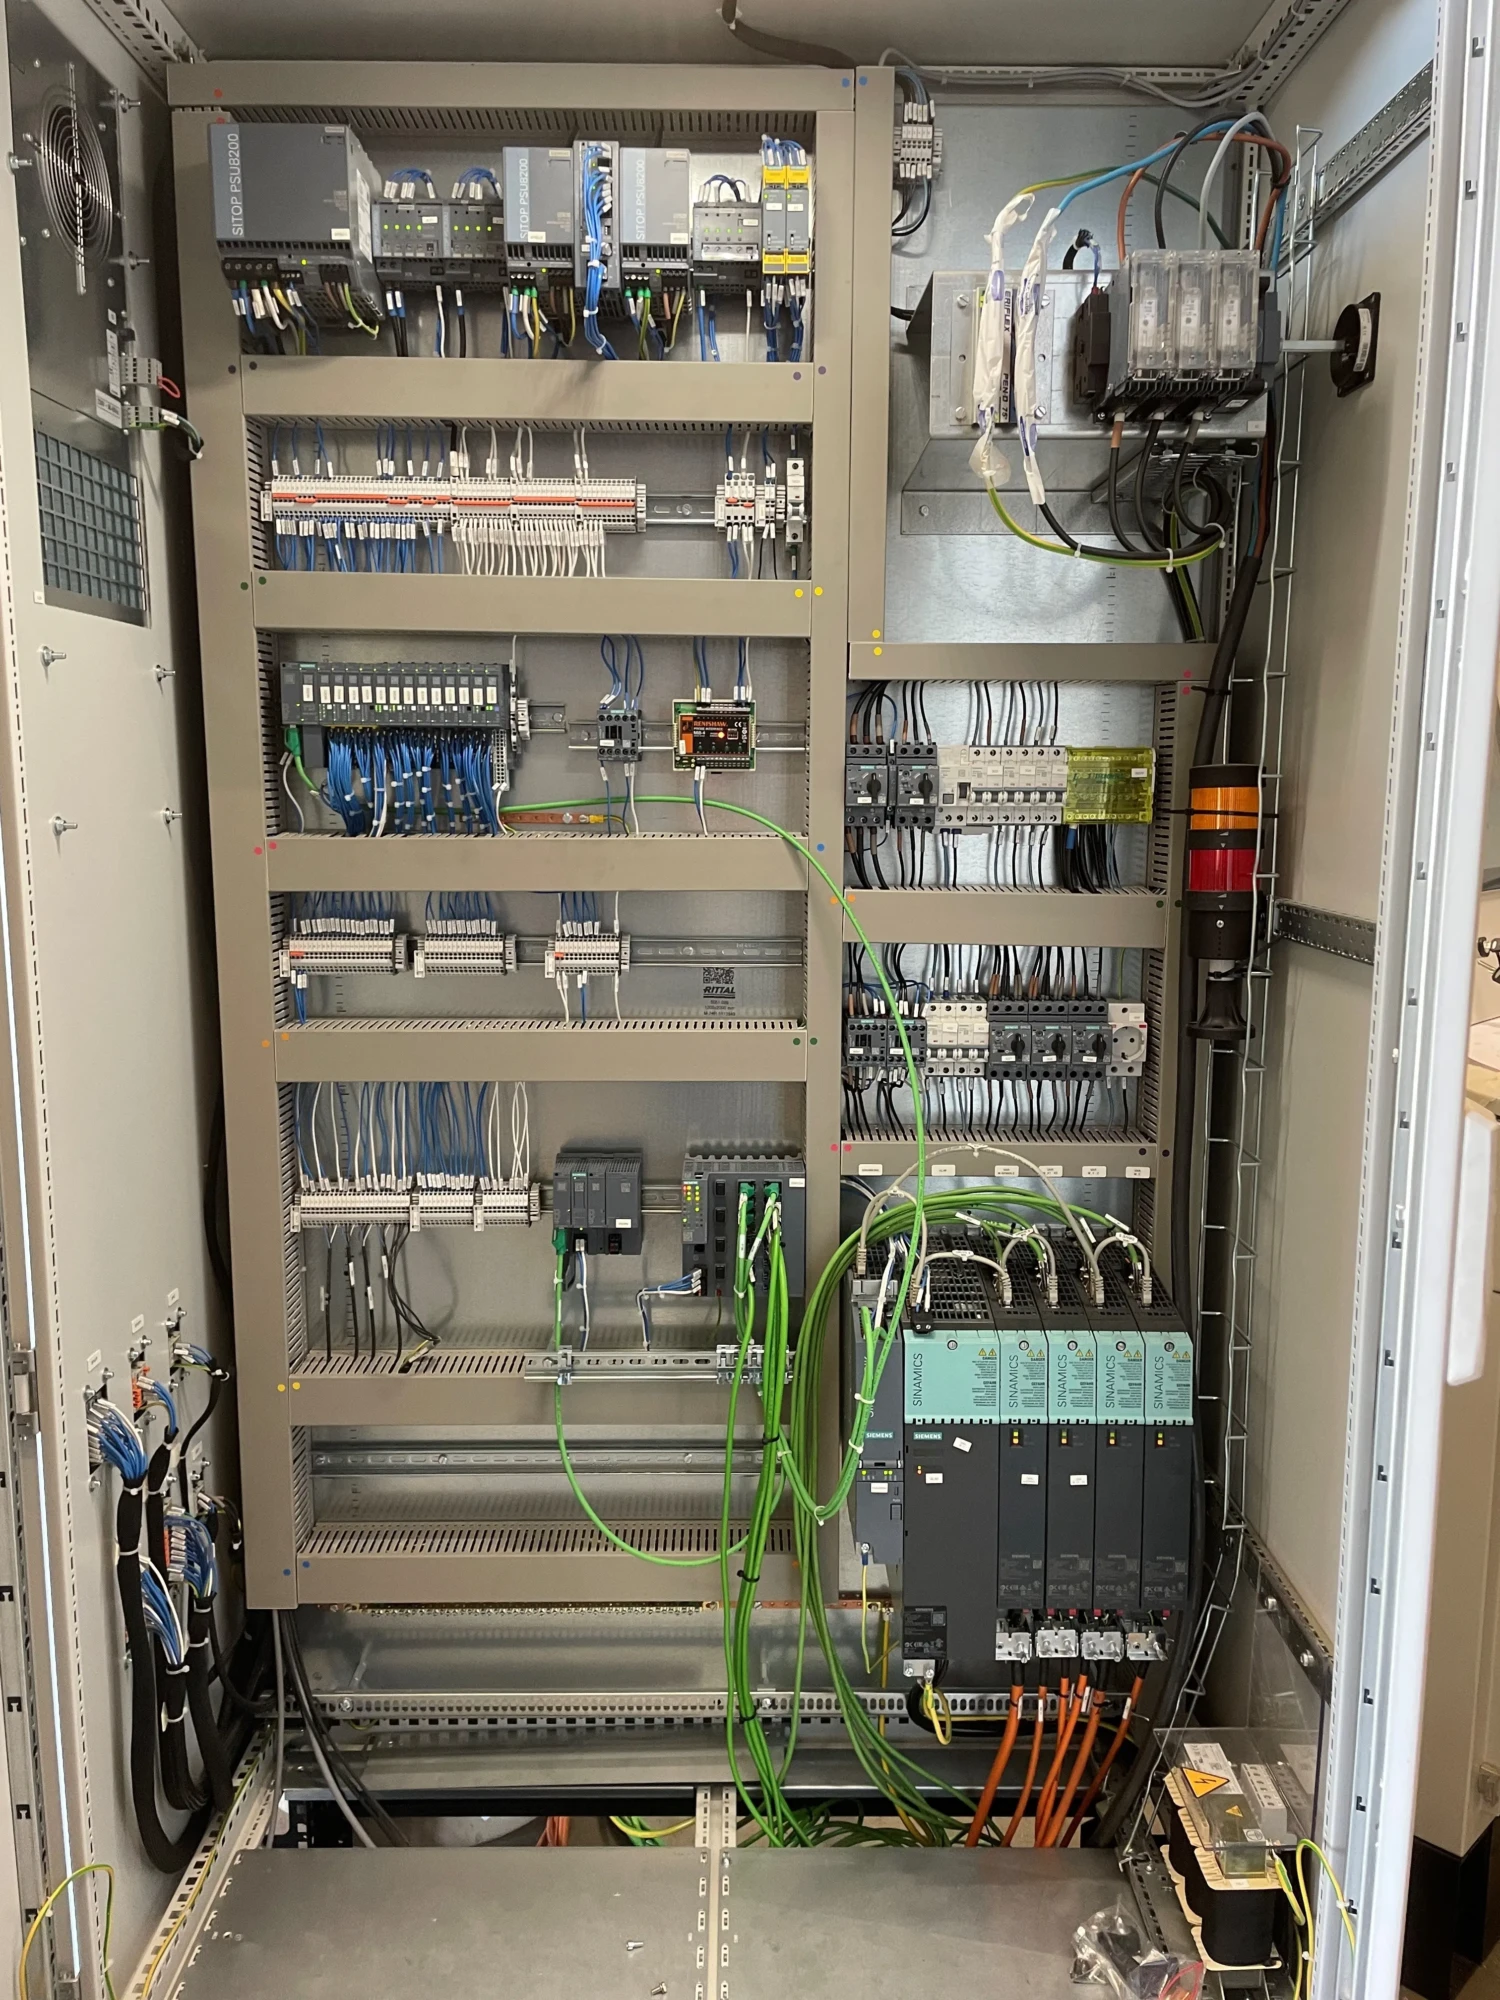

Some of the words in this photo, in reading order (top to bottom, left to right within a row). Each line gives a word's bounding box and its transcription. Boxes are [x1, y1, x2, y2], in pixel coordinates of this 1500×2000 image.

[227, 133, 241, 193] PSU8200
[518, 158, 529, 206] PSU8200
[635, 159, 646, 206] PSU8200
[231, 196, 244, 236] SITOP
[519, 207, 529, 240] SITOP
[635, 208, 646, 240] SITOP
[1003, 290, 1011, 332] ERIFLEX
[703, 986, 736, 994] RITTAL
[912, 1353, 923, 1406] SINAMICS
[1008, 1354, 1018, 1408] SINAMICS
[1057, 1354, 1067, 1407] SINAMICS
[1105, 1355, 1115, 1408] SINAMICS
[1154, 1356, 1164, 1409] SINAMICS
